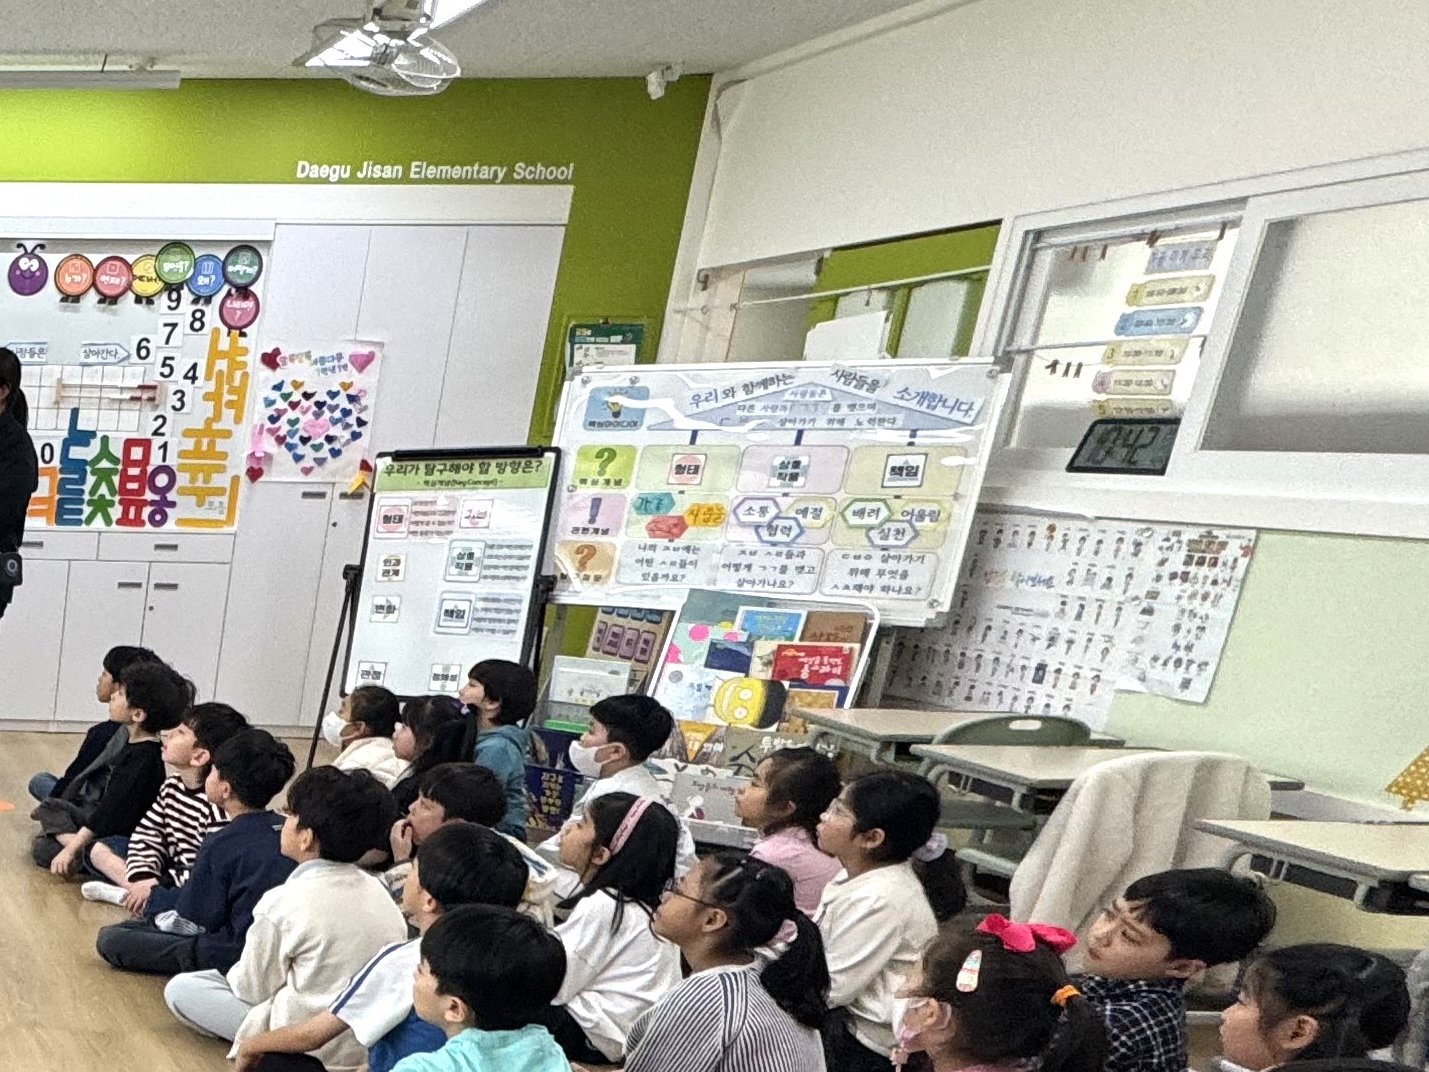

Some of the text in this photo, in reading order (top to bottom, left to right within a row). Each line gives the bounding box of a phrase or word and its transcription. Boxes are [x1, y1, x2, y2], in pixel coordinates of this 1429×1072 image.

[296, 160, 574, 183] Daegu Jisan Elementary School
[196, 274, 216, 287] 왜?
[167, 288, 182, 311] 9
[189, 308, 206, 333] 8
[163, 322, 179, 346] 7
[135, 337, 151, 361] 6
[159, 356, 175, 379] 5
[183, 362, 199, 385] 4
[830, 368, 881, 394] 사람들을
[171, 389, 186, 412] 3
[151, 414, 167, 437] 2
[40, 442, 54, 464] 0
[157, 440, 169, 464] 1
[384, 459, 544, 477] 우리가 탐구해야 할 방향은?
[674, 463, 701, 476] 형태
[888, 464, 920, 478] 책임
[742, 505, 770, 519] 소통
[794, 506, 824, 521] 예절
[851, 507, 882, 521] 배려
[900, 508, 942, 523] 어울림
[877, 526, 907, 541] 실천
